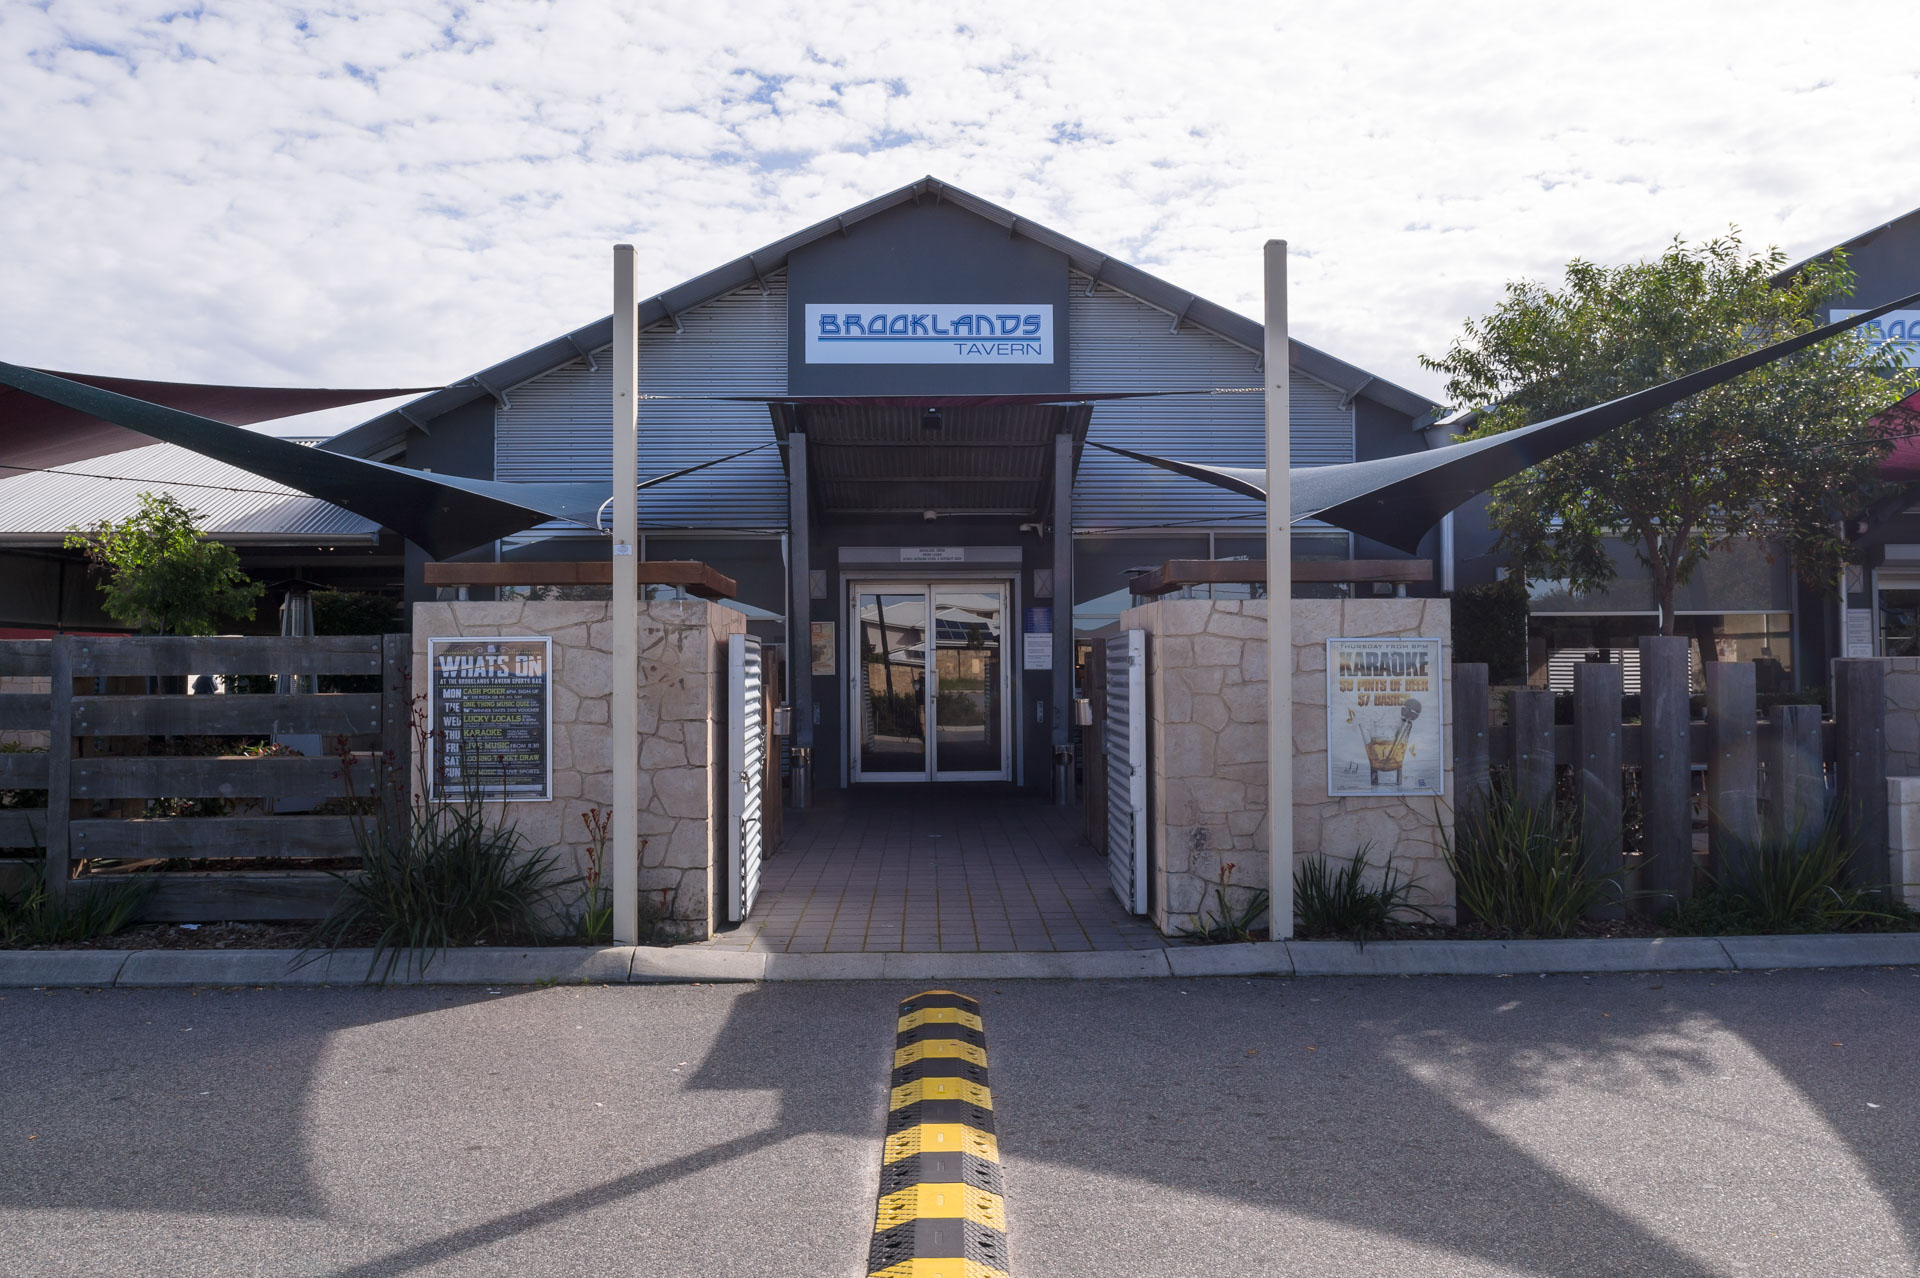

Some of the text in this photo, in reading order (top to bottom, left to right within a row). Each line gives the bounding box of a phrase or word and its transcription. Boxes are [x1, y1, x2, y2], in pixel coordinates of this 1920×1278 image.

[819, 314, 1041, 335] BROOKLANDS
[953, 343, 1042, 356] TAVERN
[439, 656, 542, 677] WHATS ON
[1340, 652, 1429, 677] KARAOKE
[1357, 679, 1387, 692] PINTS
[1390, 679, 1402, 692] OF
[1405, 679, 1429, 692] BEER
[443, 689, 461, 699] MON
[445, 702, 460, 712] TUE
[443, 717, 461, 726] WED
[444, 730, 460, 740] THU
[463, 729, 502, 737] KARAOKE
[446, 743, 459, 752] FRI
[444, 756, 460, 766] SAT
